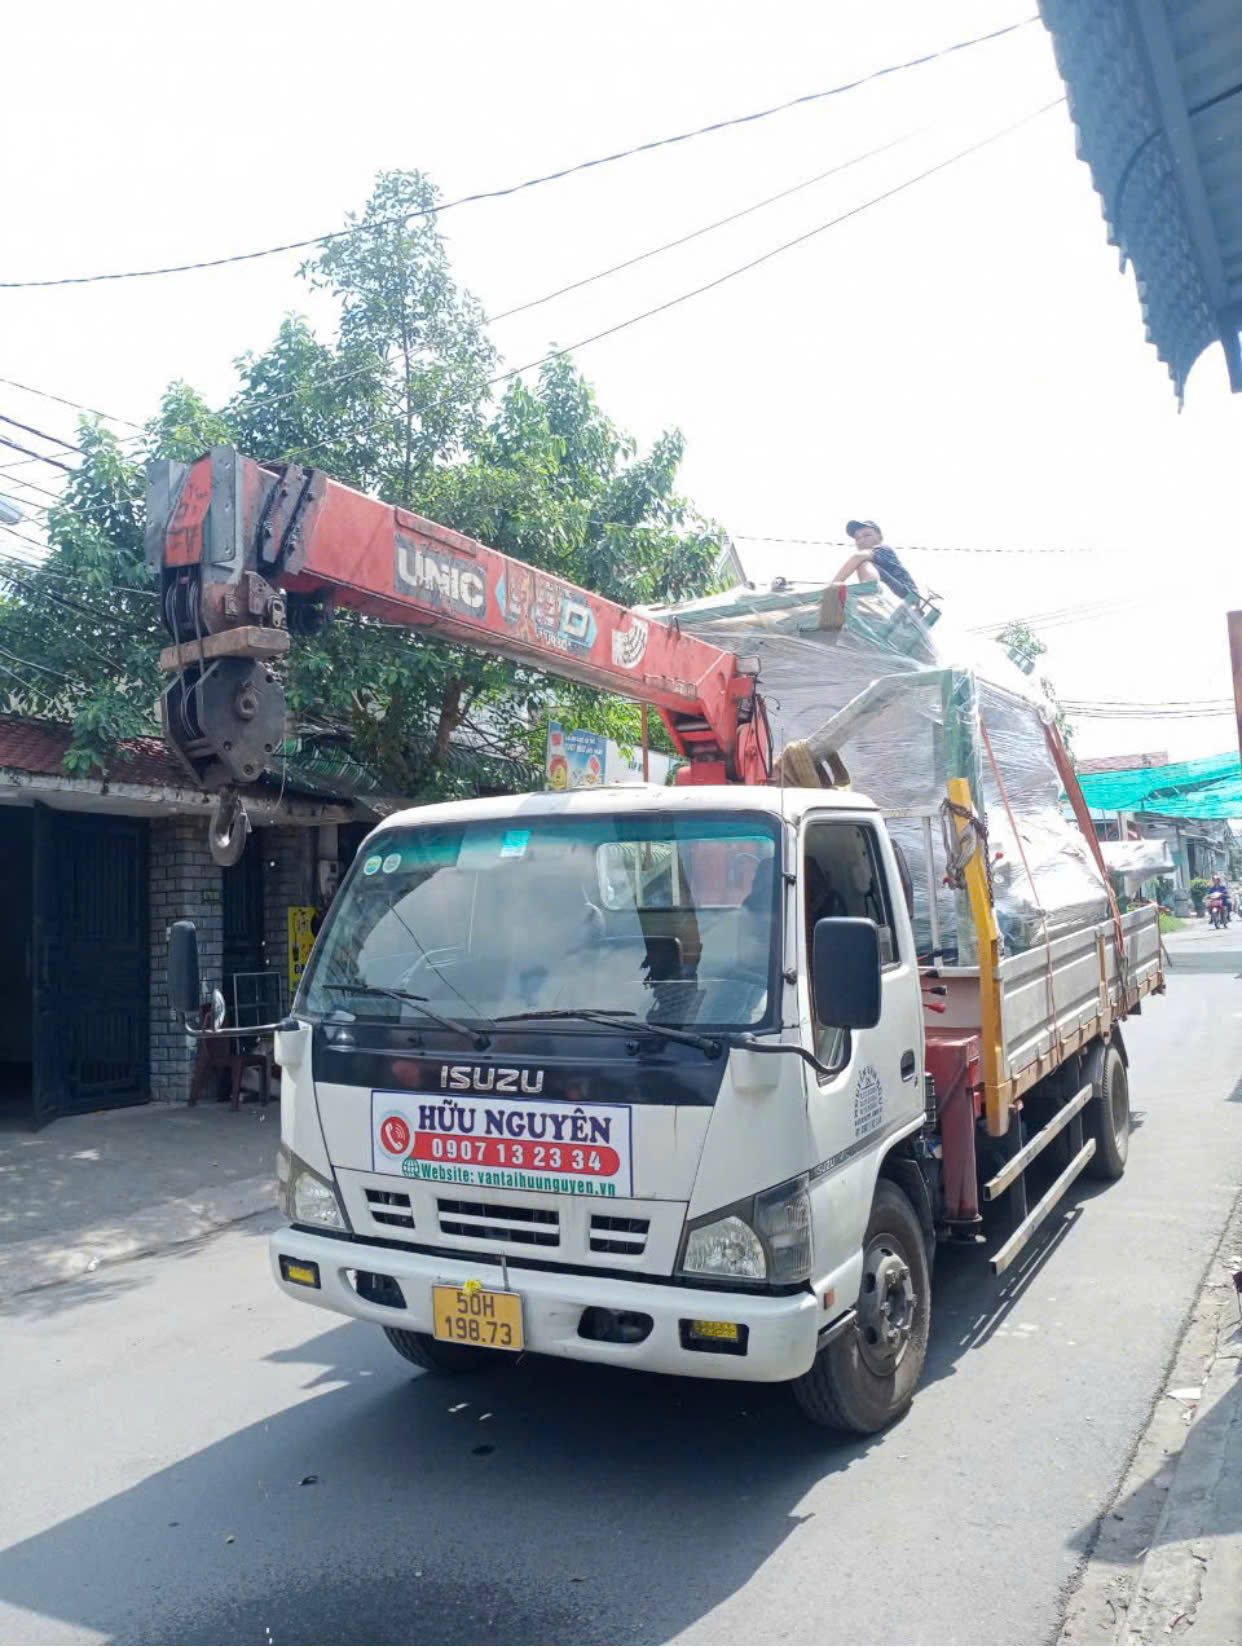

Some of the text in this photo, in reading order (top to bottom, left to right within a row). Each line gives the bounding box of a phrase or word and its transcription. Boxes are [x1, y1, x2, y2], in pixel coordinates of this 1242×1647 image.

[397, 546, 484, 608] UNIC
[441, 1065, 544, 1092] ISUZU
[418, 1099, 612, 1144] HỮU NGUYÊN
[431, 1138, 602, 1171] 0907 13 23 34
[421, 1163, 615, 1196] Website: vantaihuunguyen.vn
[457, 1292, 494, 1318] 50H
[445, 1316, 511, 1345] 198.73
